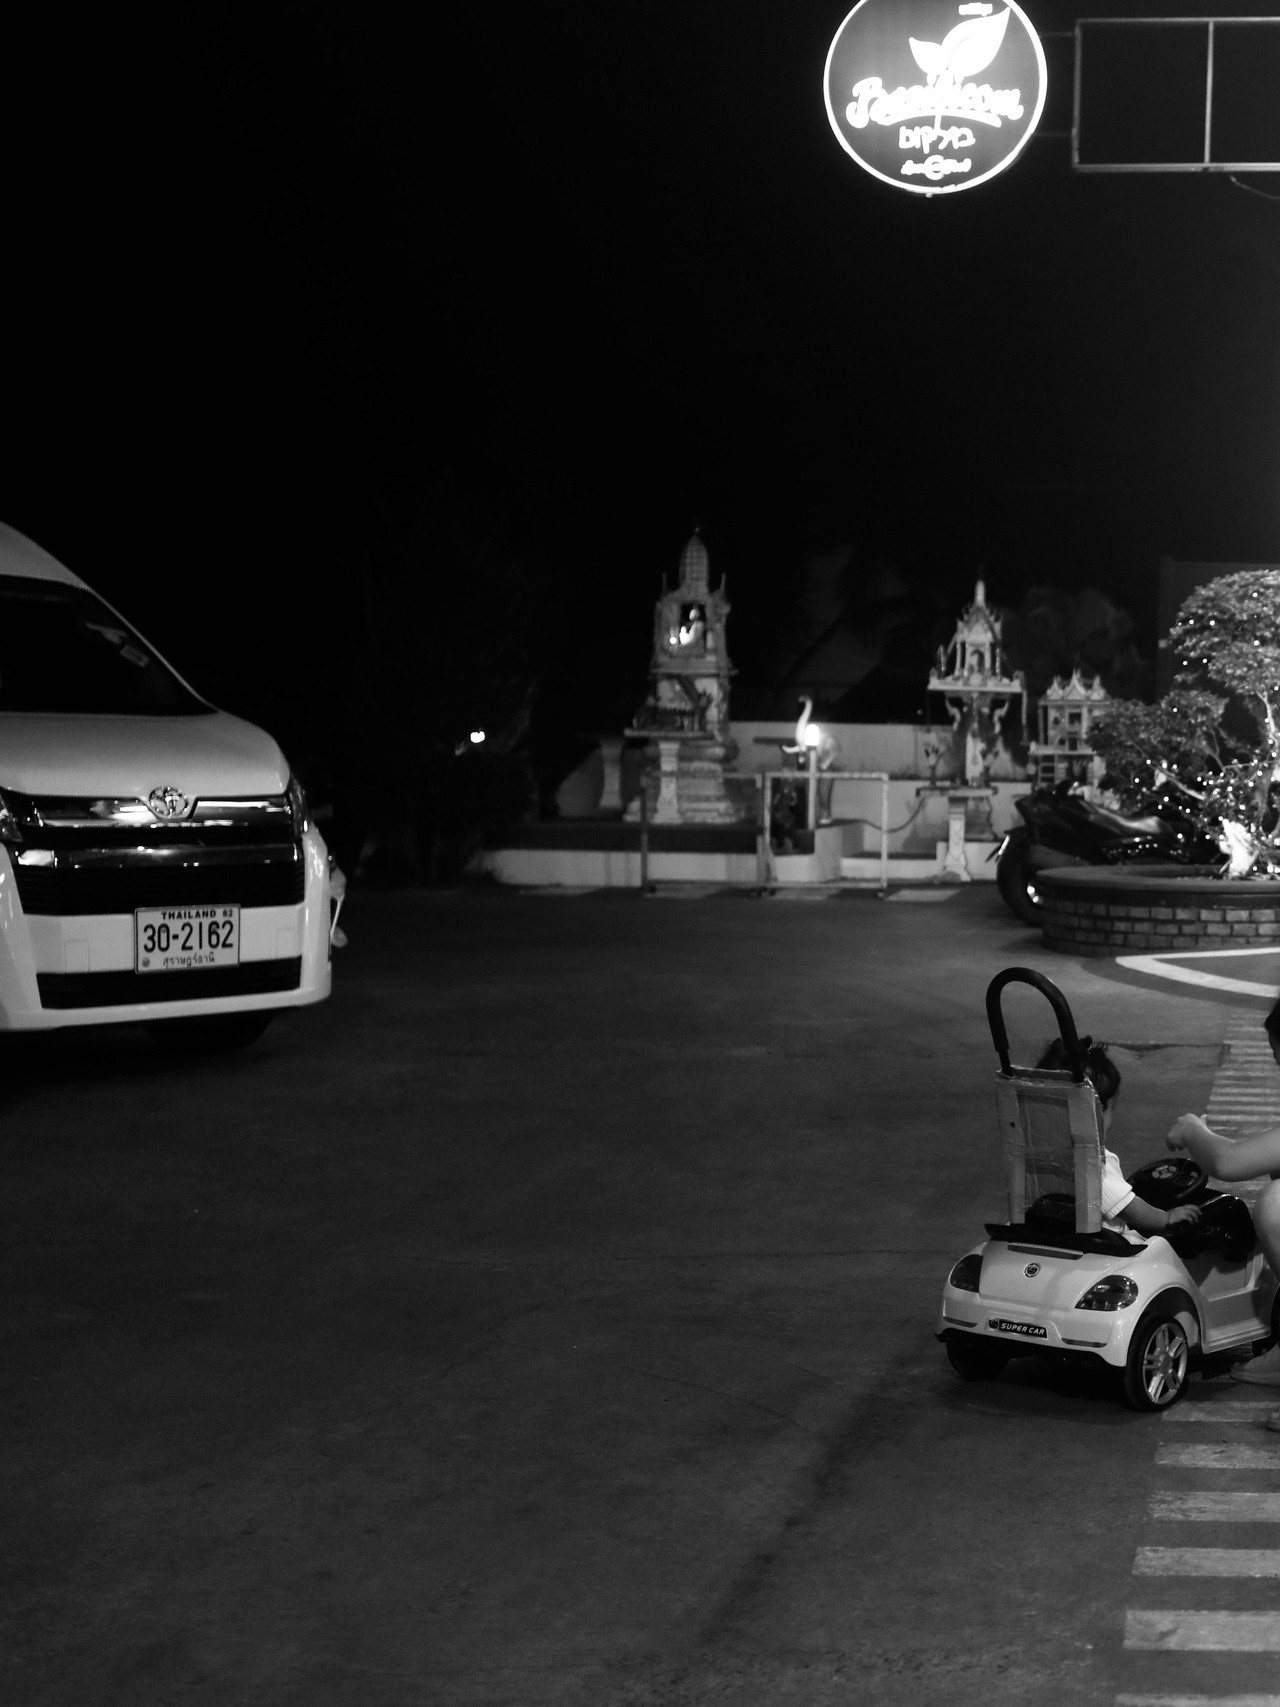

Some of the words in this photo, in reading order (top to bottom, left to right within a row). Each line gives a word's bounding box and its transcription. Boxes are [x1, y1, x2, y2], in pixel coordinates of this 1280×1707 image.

[161, 909, 217, 921] THAILAND
[143, 919, 234, 953] 30-2162
[1000, 1322, 1028, 1333] SUPER
[1028, 1327, 1045, 1336] CAR
